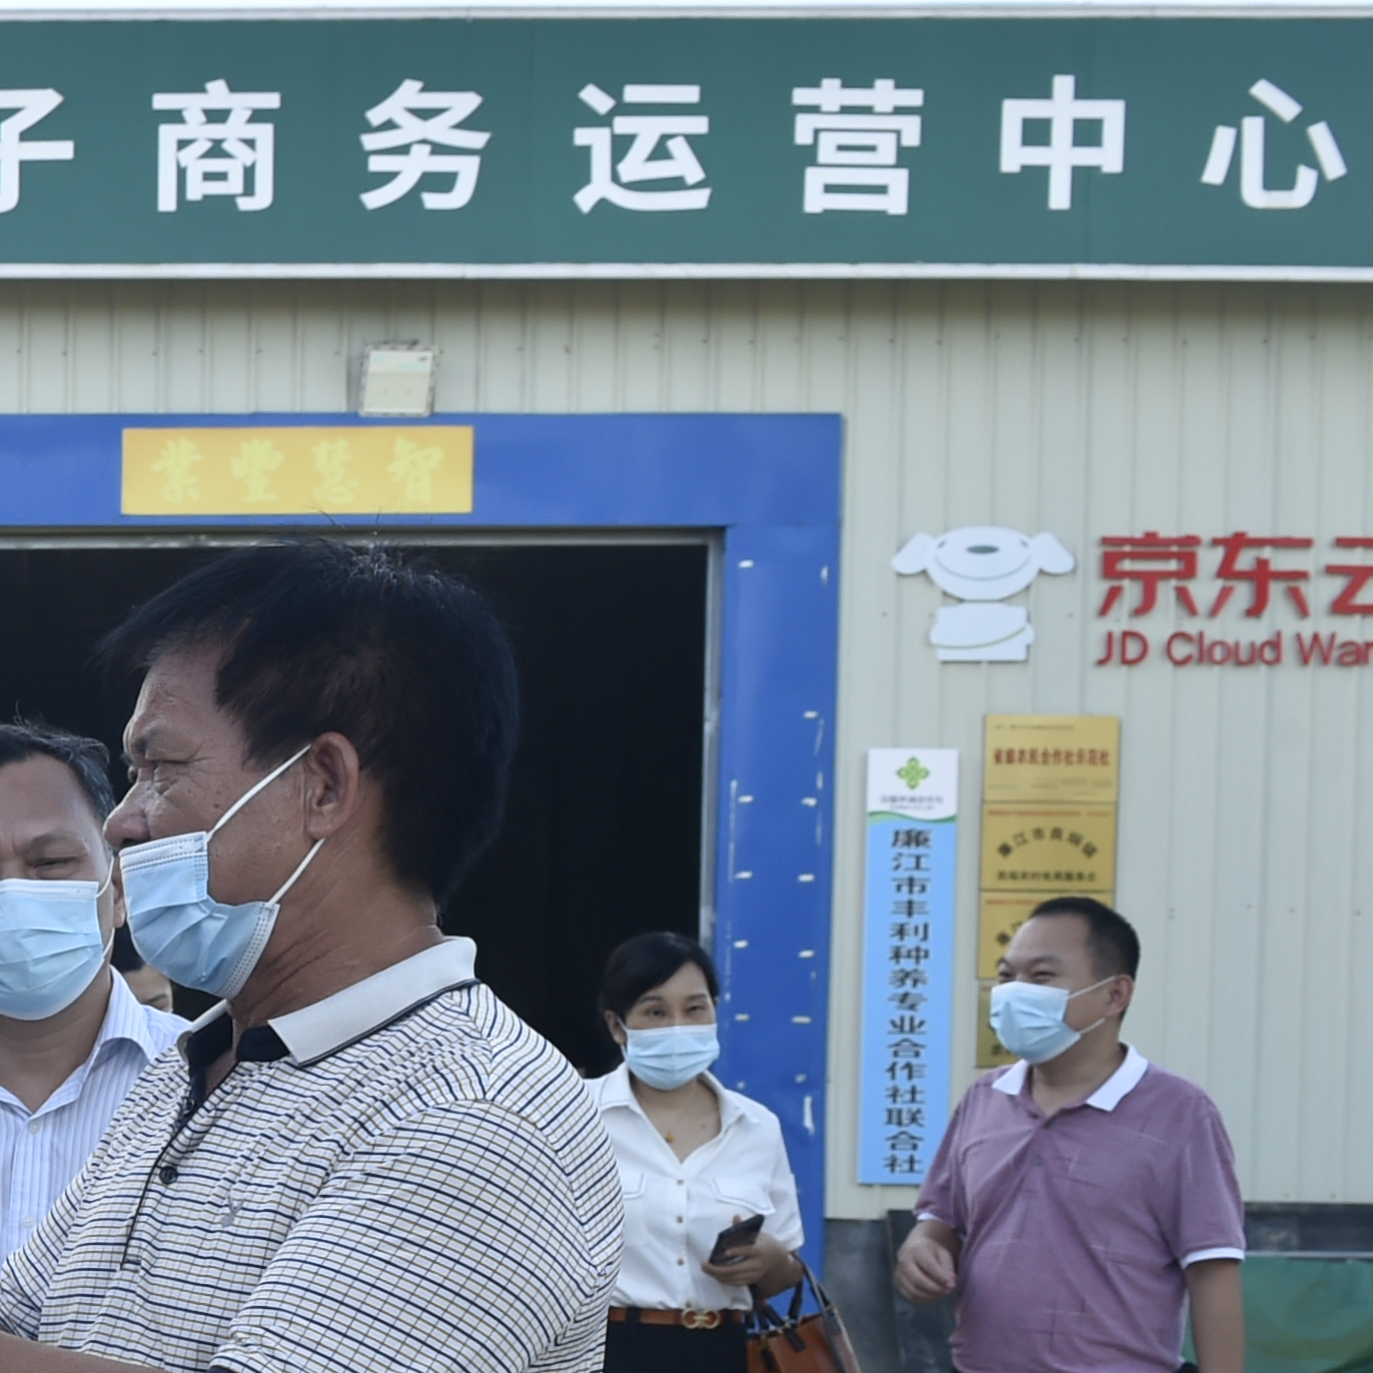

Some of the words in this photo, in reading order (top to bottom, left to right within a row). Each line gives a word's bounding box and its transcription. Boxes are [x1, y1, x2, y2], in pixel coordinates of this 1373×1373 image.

[1097, 631, 1149, 667] JD
[1165, 630, 1282, 667] Cloud
[883, 828, 932, 1174] 廉江市丰利种养专业合作社联合社
